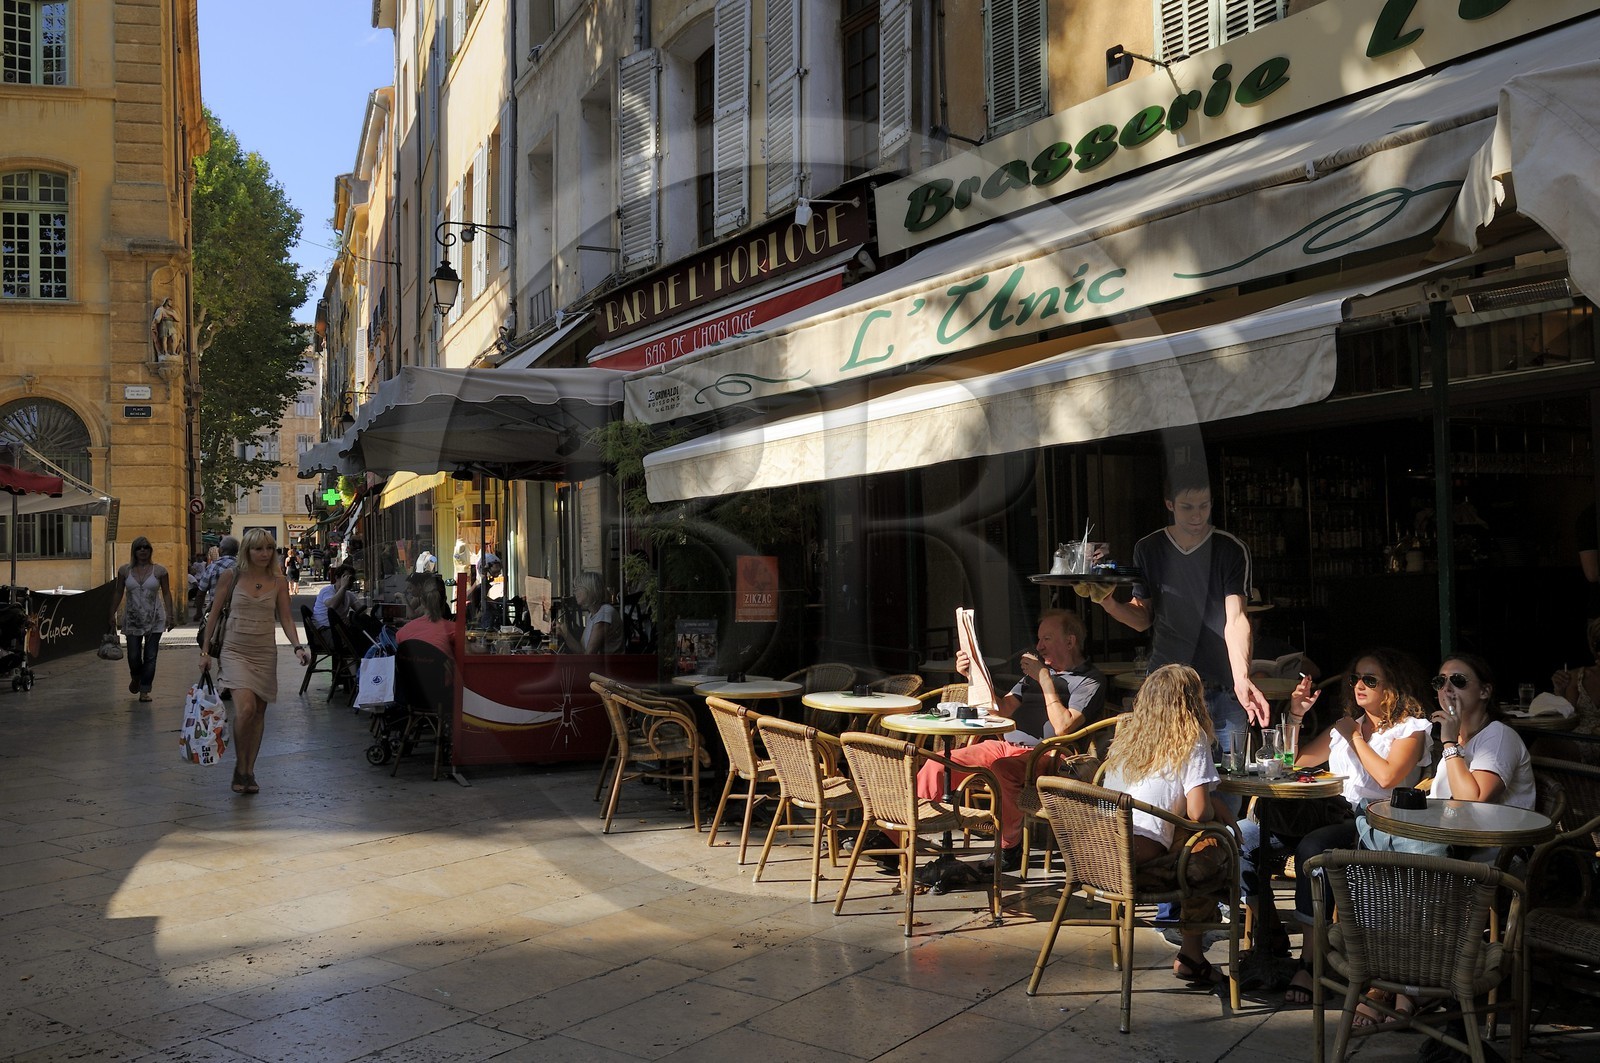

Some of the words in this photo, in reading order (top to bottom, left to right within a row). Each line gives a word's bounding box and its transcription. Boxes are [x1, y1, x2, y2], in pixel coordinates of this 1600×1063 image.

[905, 56, 1291, 233] Brasserie
[605, 289, 647, 333] BAR
[653, 274, 682, 315] DE
[839, 262, 1127, 372] L'Unic
[645, 342, 666, 366] BAR
[671, 334, 687, 358] DE
[744, 593, 772, 604] ZIKZAC
